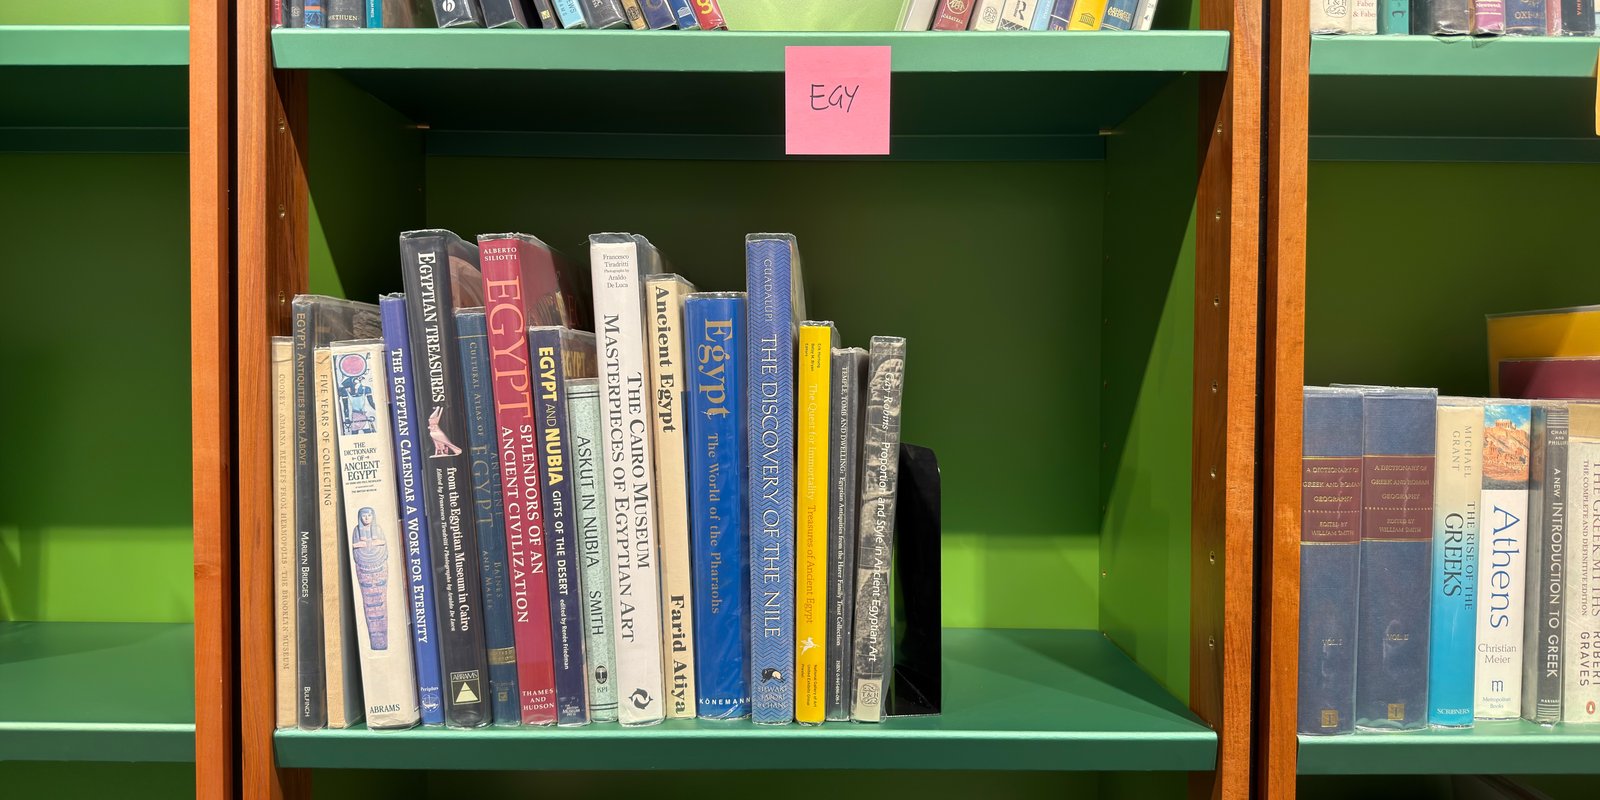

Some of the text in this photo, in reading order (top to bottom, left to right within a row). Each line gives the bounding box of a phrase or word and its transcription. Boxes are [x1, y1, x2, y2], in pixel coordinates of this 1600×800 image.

[810, 84, 859, 113] EGY
[484, 254, 517, 262] SILIOTTI
[764, 258, 773, 322] GUADALUPI
[417, 252, 446, 403] EGYPTIAN TREASURES
[486, 276, 531, 418] EGYPT
[655, 286, 676, 433] Ancient Egypt
[296, 313, 308, 466] EGYPT: ANTIQUITIES FROM ABOVE
[469, 342, 484, 436] CULTURAL ATLAS OF
[279, 450, 287, 483] RELIEFS
[320, 374, 332, 506] FIVE YEARS OF COLLECTING
[343, 448, 377, 456] DICTIONARY
[343, 460, 380, 472] ANCIENT
[538, 347, 568, 596] EGYPT AND NUBIA GIFTS OF THE DESERT
[627, 372, 651, 570] THE CAIRO MUSEUM
[698, 318, 733, 614] Egypt The World of the Pharaohs
[1452, 430, 1460, 472] GRANT
[1464, 426, 1472, 478] MICHAEL
[1582, 459, 1590, 475] THE
[347, 470, 378, 481] EGYPT
[391, 348, 428, 644] THE EGYPTIAN CALENDAR A WORK FOR ETERNITY
[470, 444, 493, 528] EGYPT
[520, 424, 544, 574] SPLENDORS OF AN
[603, 314, 636, 643] MASTERPIECES OF EGYPTIAN ART
[761, 334, 781, 638] THE DISCOVERY OF THE NILE
[804, 384, 817, 623] The Quest for Immortality Treasures of Ancient Egypt
[1553, 477, 1561, 498] NEW
[280, 511, 288, 565] HERMOPOLIS
[446, 467, 470, 632] from the Egyptian Museum in Cairo
[502, 427, 529, 623] ANCIENT CIVILIZATION
[577, 436, 604, 635] ASKUT IN NUBIA SMITH
[868, 372, 894, 662] Gay Robins Proportion and Style in Ancient Egyptian Art
[1591, 463, 1600, 616] THE GREEK MYTHS
[300, 531, 310, 598] MARILYN BRIDGES
[1443, 512, 1464, 597] GREEKS
[1464, 502, 1476, 610] THE RISE OF THE
[1489, 505, 1521, 629] Athens
[1550, 502, 1563, 604] INTRODUCTION
[559, 599, 567, 618] edited
[560, 618, 567, 626] by
[1548, 610, 1560, 628] TO
[282, 633, 290, 671] MUSEUM
[670, 594, 688, 714] Farid Atiya
[1478, 643, 1517, 653] Christian
[1484, 654, 1511, 664] Meier
[1546, 635, 1559, 678] GREEK
[1579, 632, 1590, 686] GRAVES
[1592, 631, 1600, 685] ROBERT
[369, 704, 400, 714] ABRAMS
[522, 688, 554, 696] THAMES
[523, 703, 554, 711] HUDSON
[699, 697, 750, 705] KÖNEMANN
